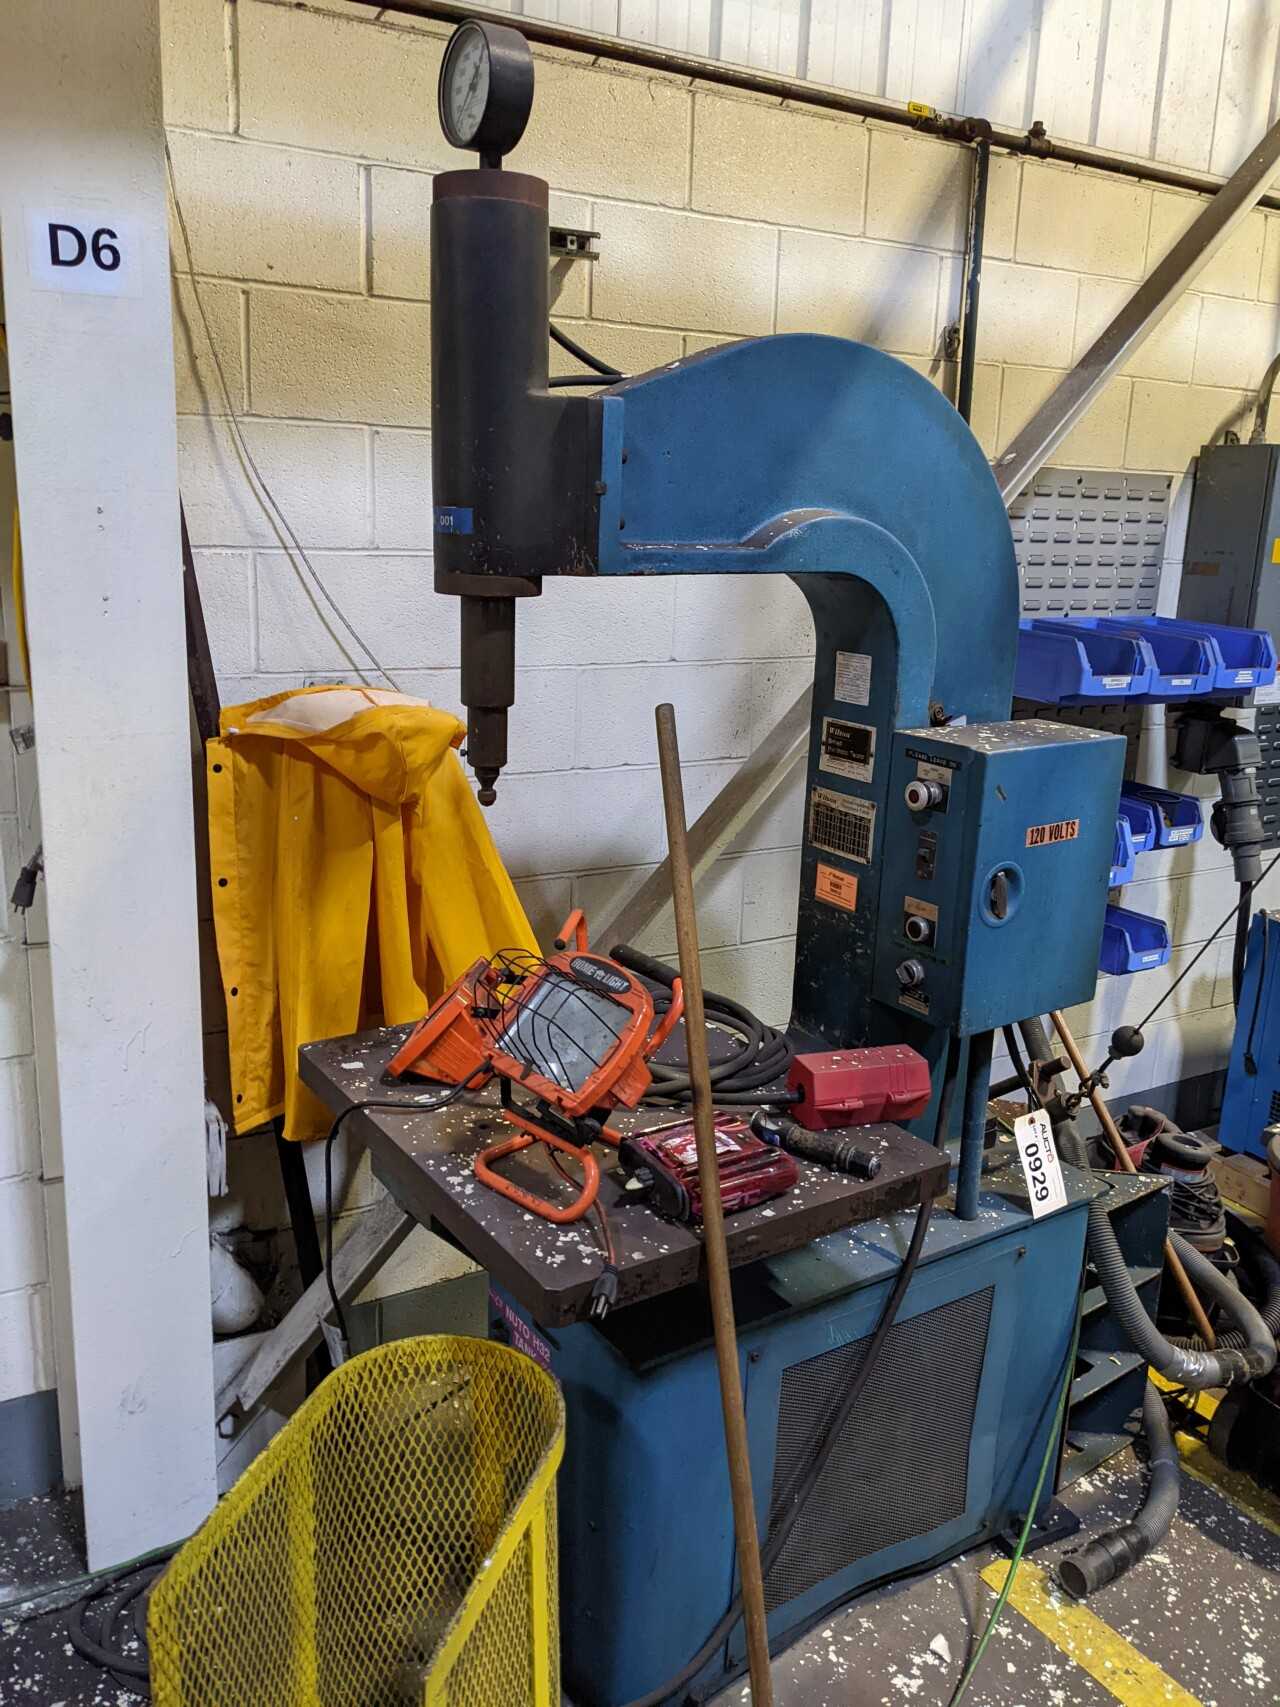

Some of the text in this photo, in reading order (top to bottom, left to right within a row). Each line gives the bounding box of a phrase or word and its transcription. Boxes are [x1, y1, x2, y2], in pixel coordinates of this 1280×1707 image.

[48, 223, 121, 272] D6
[1029, 821, 1076, 846] 120 VOLTS
[1025, 1143, 1049, 1202] 0929
[504, 1304, 530, 1340] NUTO
